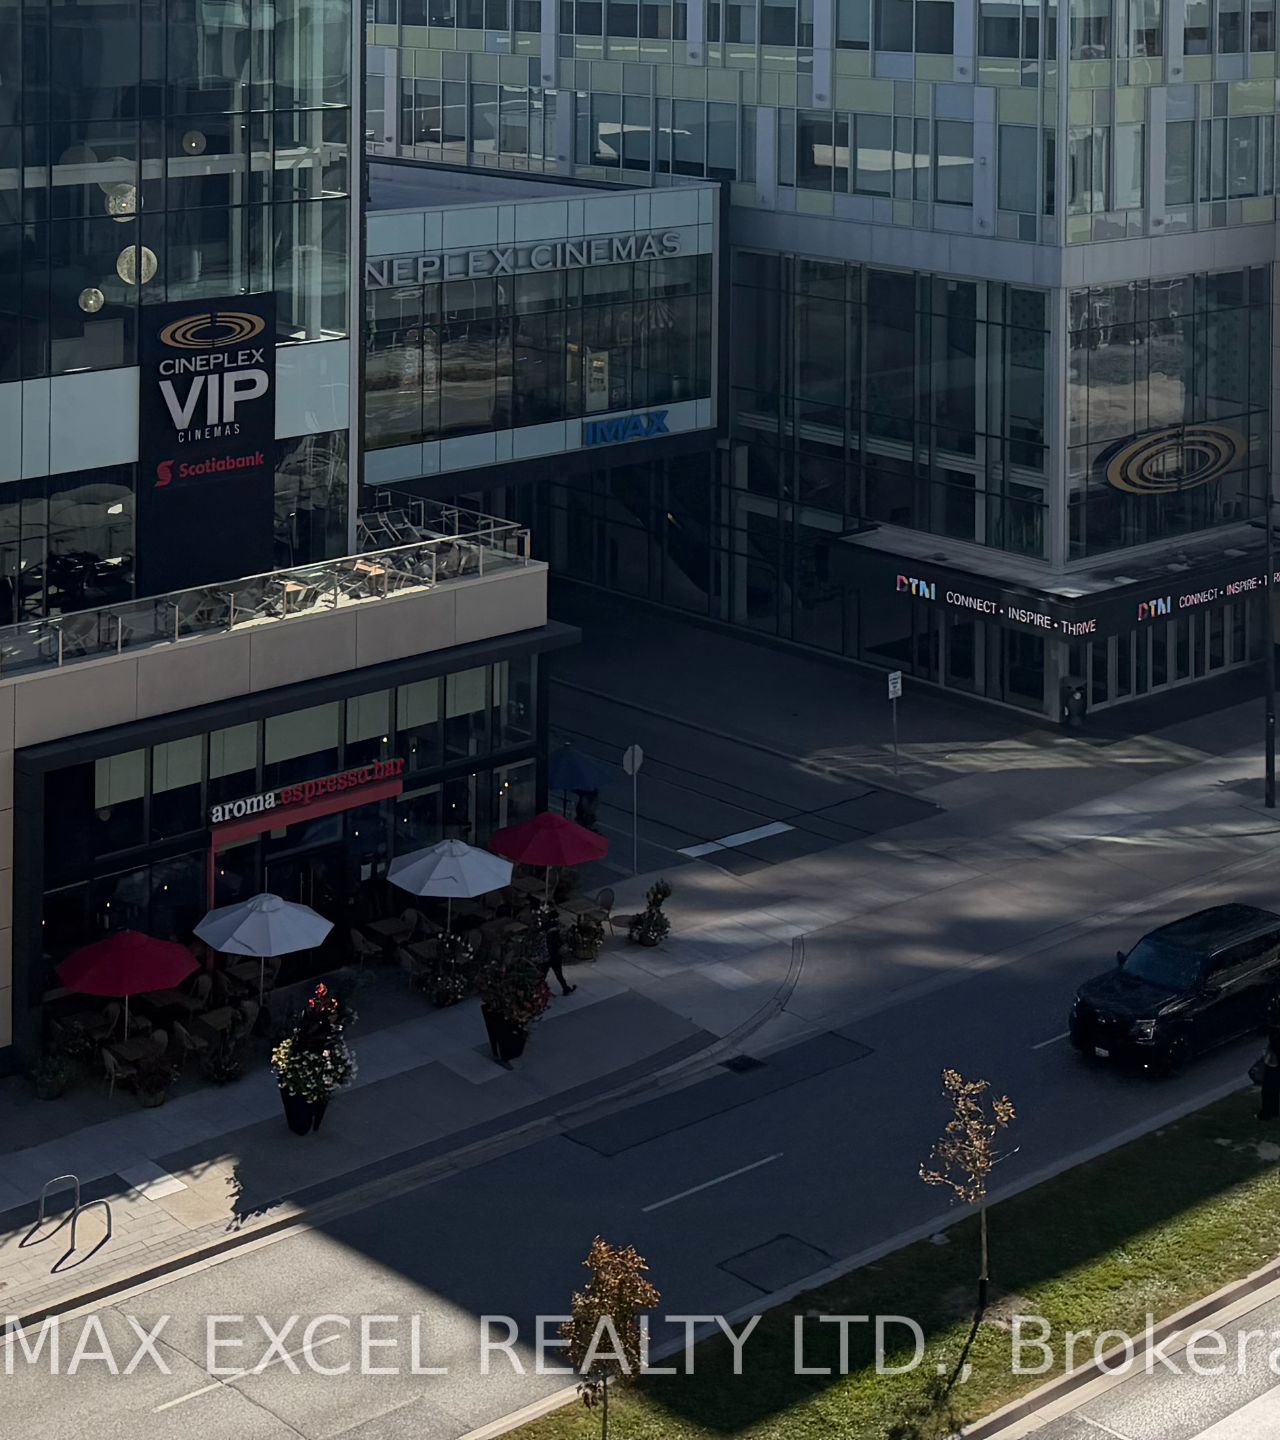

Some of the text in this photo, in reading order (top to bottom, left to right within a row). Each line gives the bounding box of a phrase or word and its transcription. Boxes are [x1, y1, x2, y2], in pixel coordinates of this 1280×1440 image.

[365, 231, 682, 288] NEPLEX CINEMAS
[159, 348, 265, 376] CINEPLEX
[158, 368, 270, 431] VIP
[178, 423, 240, 443] CINEMAS
[585, 410, 670, 447] IMAX
[179, 451, 265, 478] Scotiabank
[1179, 588, 1218, 608] CONNECT
[1226, 577, 1257, 596] INSPIRE
[946, 591, 997, 615] CONNECT
[1008, 606, 1051, 629] INSPIRE
[1061, 619, 1097, 636] THRIVE
[211, 757, 405, 823] aroma espresso bar
